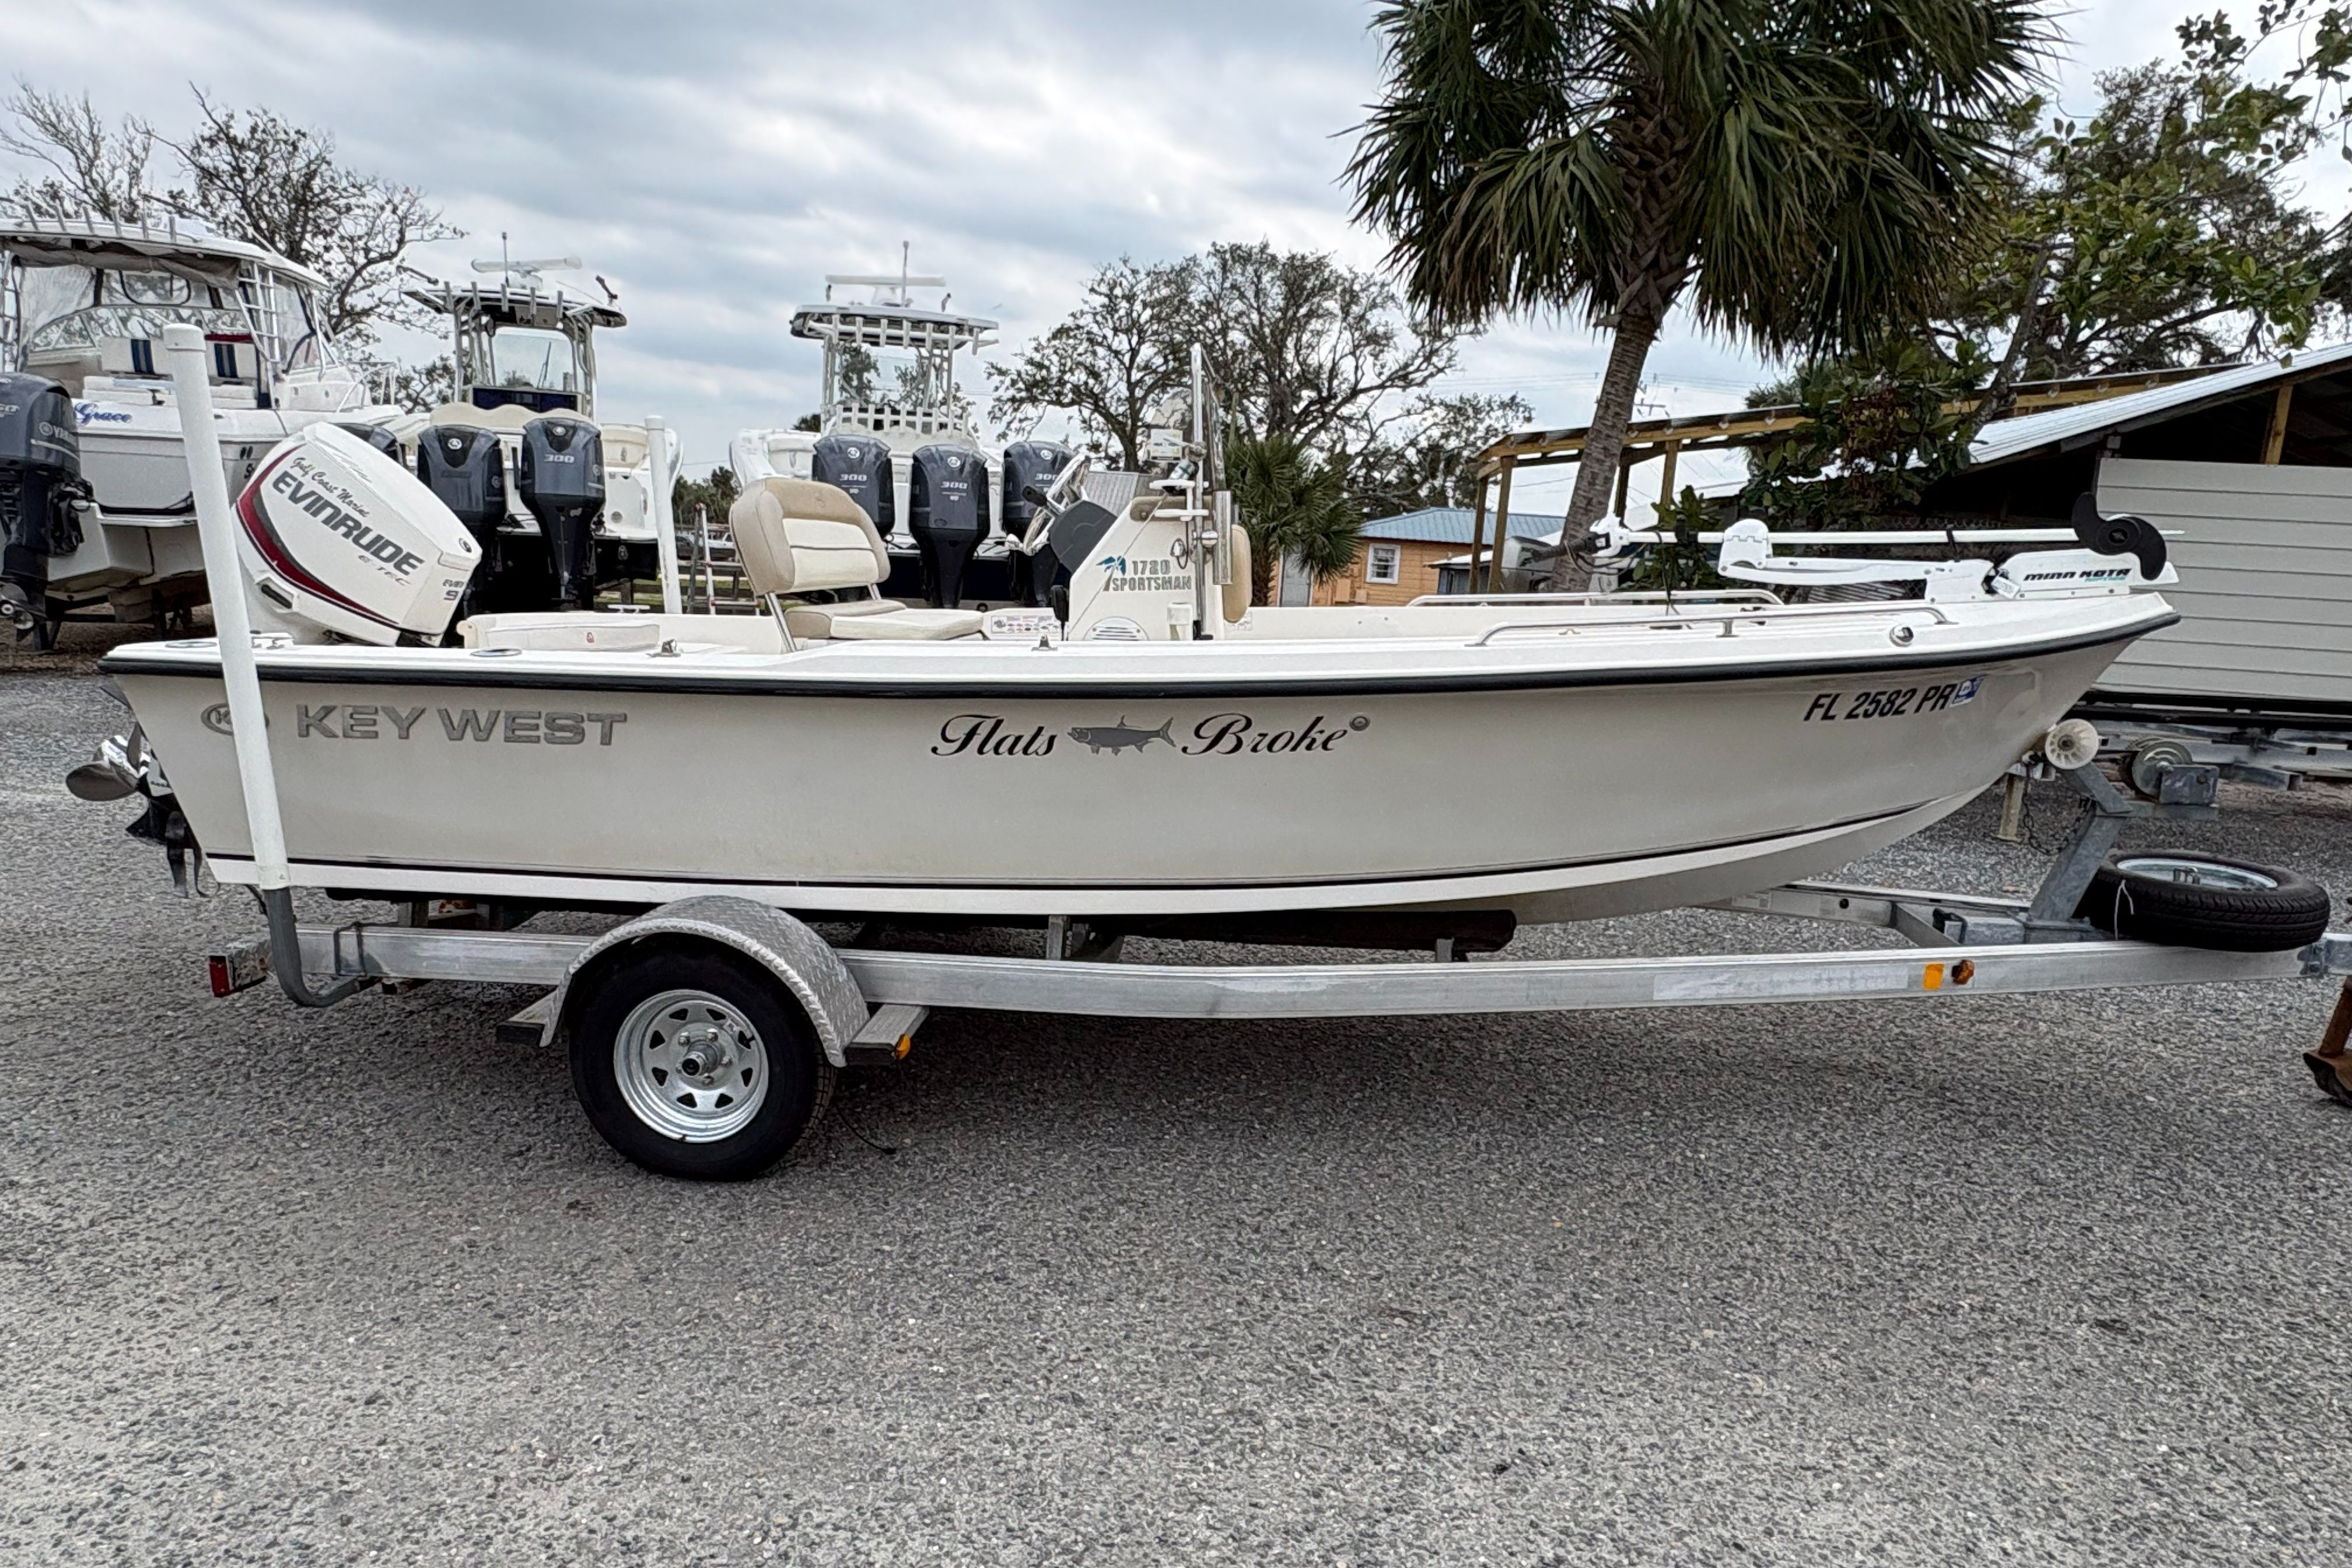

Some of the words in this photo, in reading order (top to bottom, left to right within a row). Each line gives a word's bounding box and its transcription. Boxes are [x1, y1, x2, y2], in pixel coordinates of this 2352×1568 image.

[74, 402, 133, 426] Grace
[544, 454, 575, 463] 300
[290, 457, 316, 477] Gulf
[311, 471, 340, 494] Coast
[337, 488, 370, 517] Marine
[839, 474, 867, 482] 300
[940, 481, 968, 489] 300
[272, 470, 426, 576] EVINRUDE
[1132, 559, 1171, 576] 1720
[2023, 571, 2077, 582] MINN
[2078, 568, 2132, 579] KOTA
[1112, 575, 1192, 592] SPORTSMAN
[1803, 693, 1841, 722] FL
[1843, 687, 1918, 720] 2582
[1913, 683, 1958, 715] PR
[295, 704, 427, 740] KEY
[436, 708, 628, 747] WEST
[931, 714, 1058, 757] Flats
[1181, 712, 1349, 755] Broke
